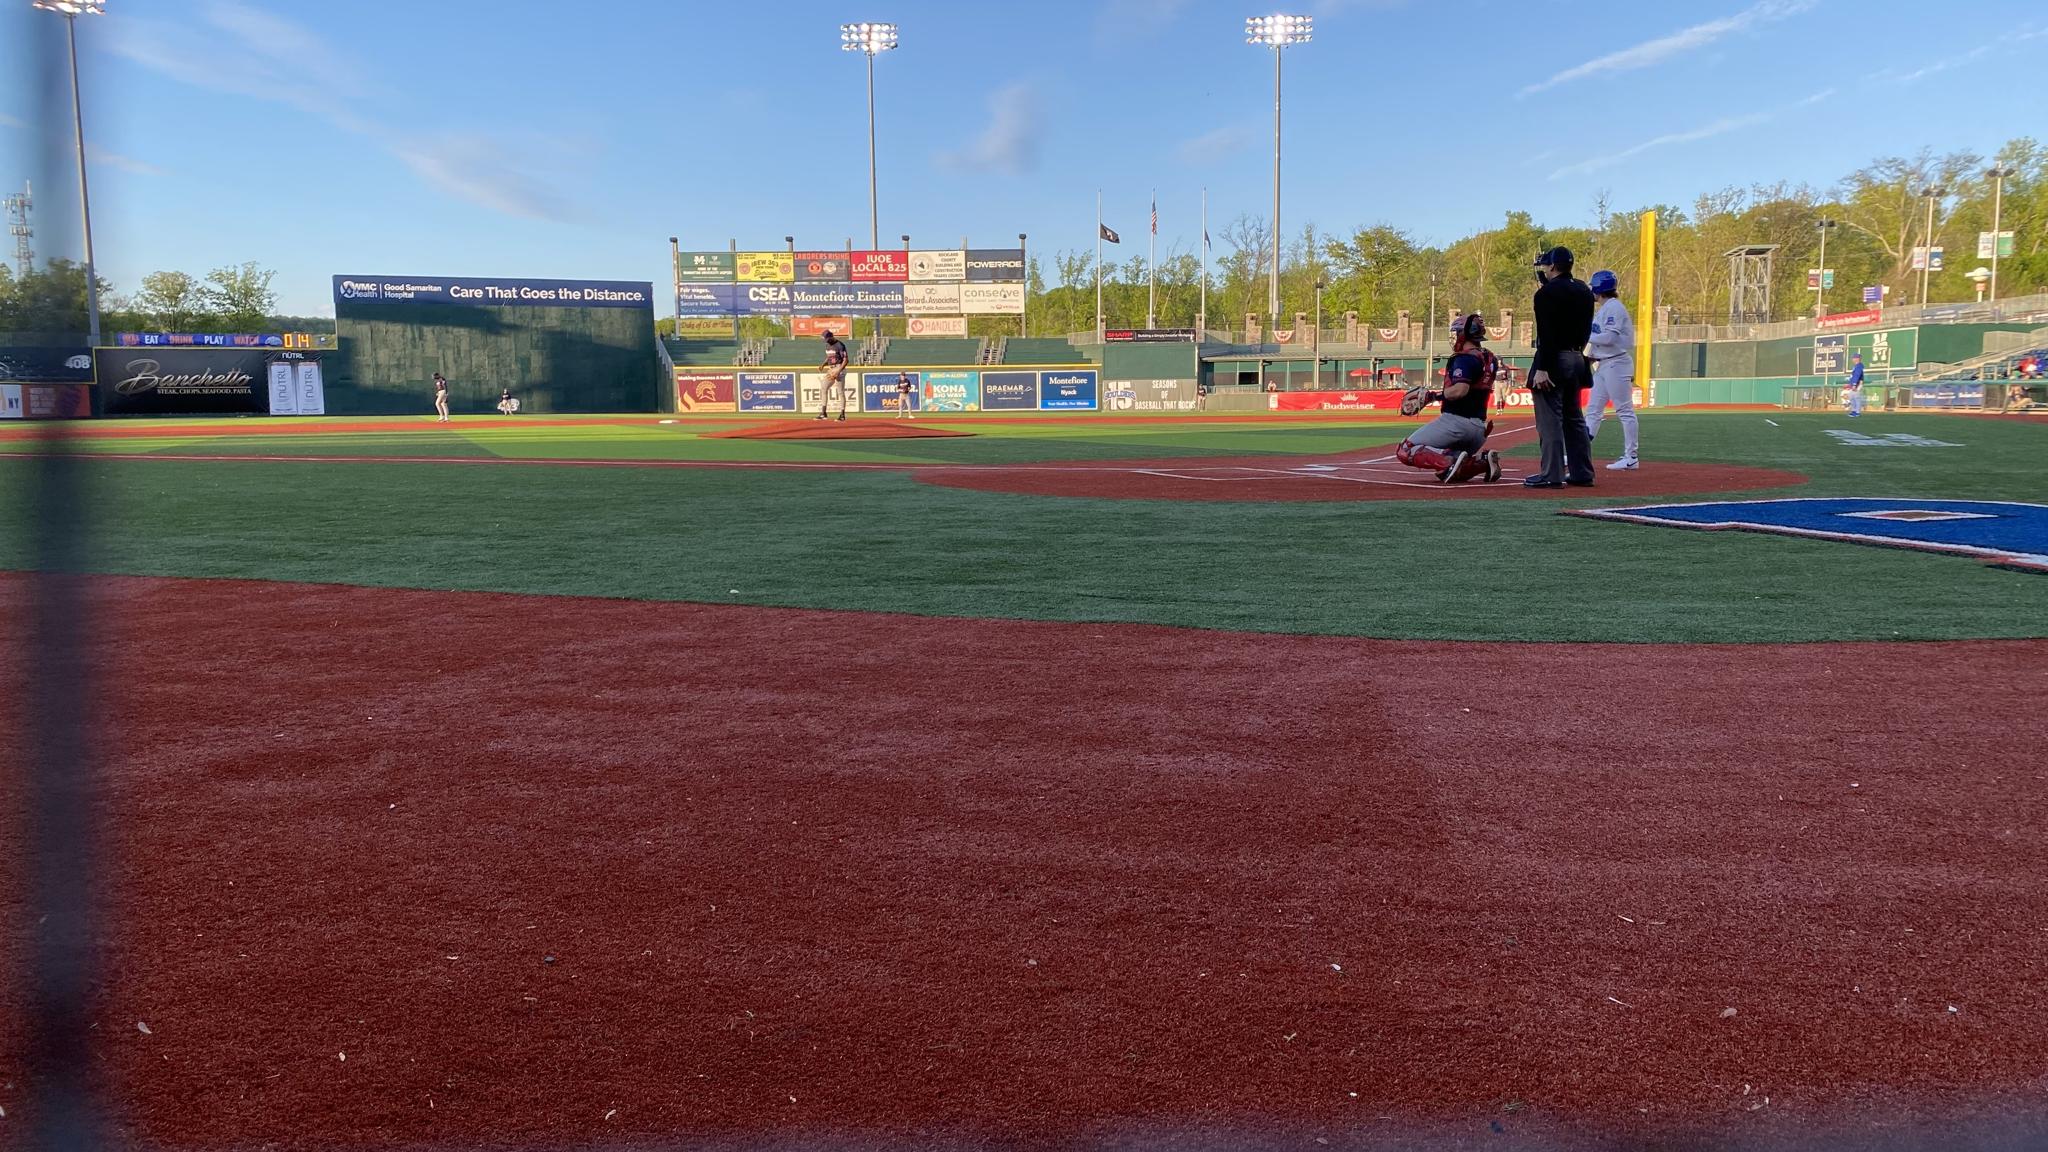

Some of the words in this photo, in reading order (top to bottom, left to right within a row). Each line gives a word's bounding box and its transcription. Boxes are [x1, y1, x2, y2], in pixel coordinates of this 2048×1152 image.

[867, 255, 892, 264] IUOE
[853, 264, 886, 272] LOCAL
[888, 264, 907, 272] 825
[353, 283, 377, 291] WMC
[384, 284, 404, 292] Good
[405, 284, 442, 293] Samaritan
[384, 291, 415, 300] Hospital
[450, 286, 483, 299] Care
[485, 286, 518, 299] That
[520, 287, 556, 300] Goes
[558, 288, 582, 300] the
[584, 288, 645, 302] Distance.
[749, 287, 790, 301] CSEA
[793, 291, 855, 302] Montefiore
[857, 291, 902, 302] Einstein
[924, 320, 963, 332] HANDLES
[144, 334, 159, 345] EAT
[204, 335, 224, 345] PLAY
[66, 359, 90, 369] 408
[115, 358, 253, 395] Banchetto
[1049, 376, 1088, 384] Montefiore
[933, 385, 966, 393] KONA
[987, 385, 1024, 393] BRAEMAR
[1152, 380, 1177, 389] SEASONS
[1104, 391, 1136, 400] BOULDERS
[1108, 381, 1133, 410] 15
[1160, 391, 1168, 399] OF
[8, 397, 19, 409] NY
[1135, 401, 1162, 410] BASEBALL
[1164, 401, 1177, 409] THAT
[1178, 400, 1196, 409] ROCKS
